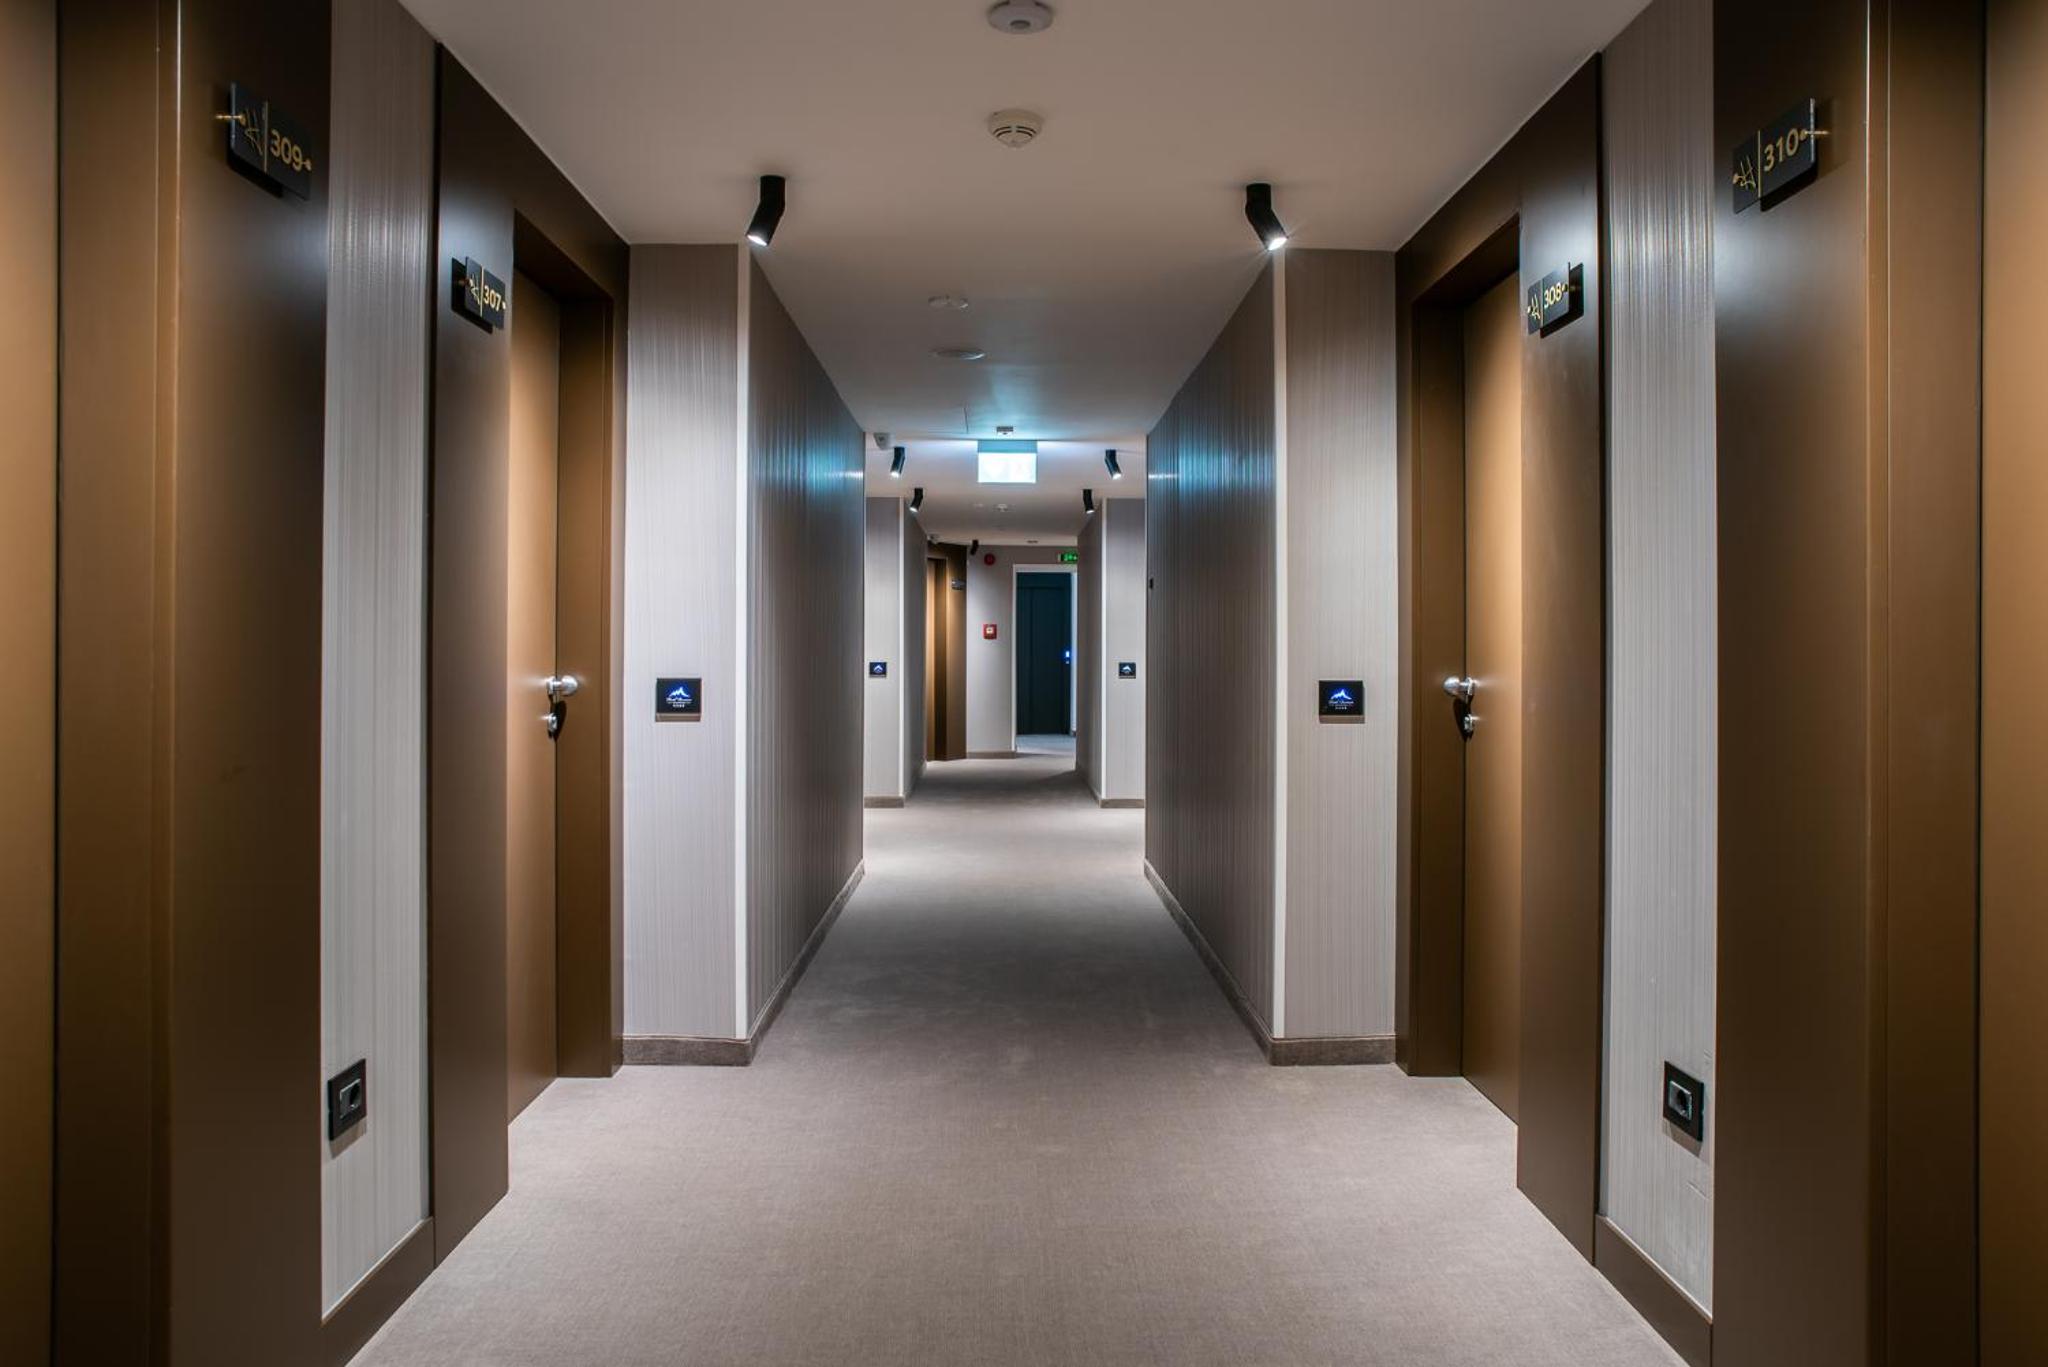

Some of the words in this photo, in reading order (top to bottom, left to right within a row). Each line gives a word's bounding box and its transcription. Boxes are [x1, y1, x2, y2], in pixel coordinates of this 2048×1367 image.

[270, 129, 302, 172] 309
[1763, 128, 1799, 172] 310
[483, 285, 501, 312] 307
[1544, 282, 1562, 309] 308
